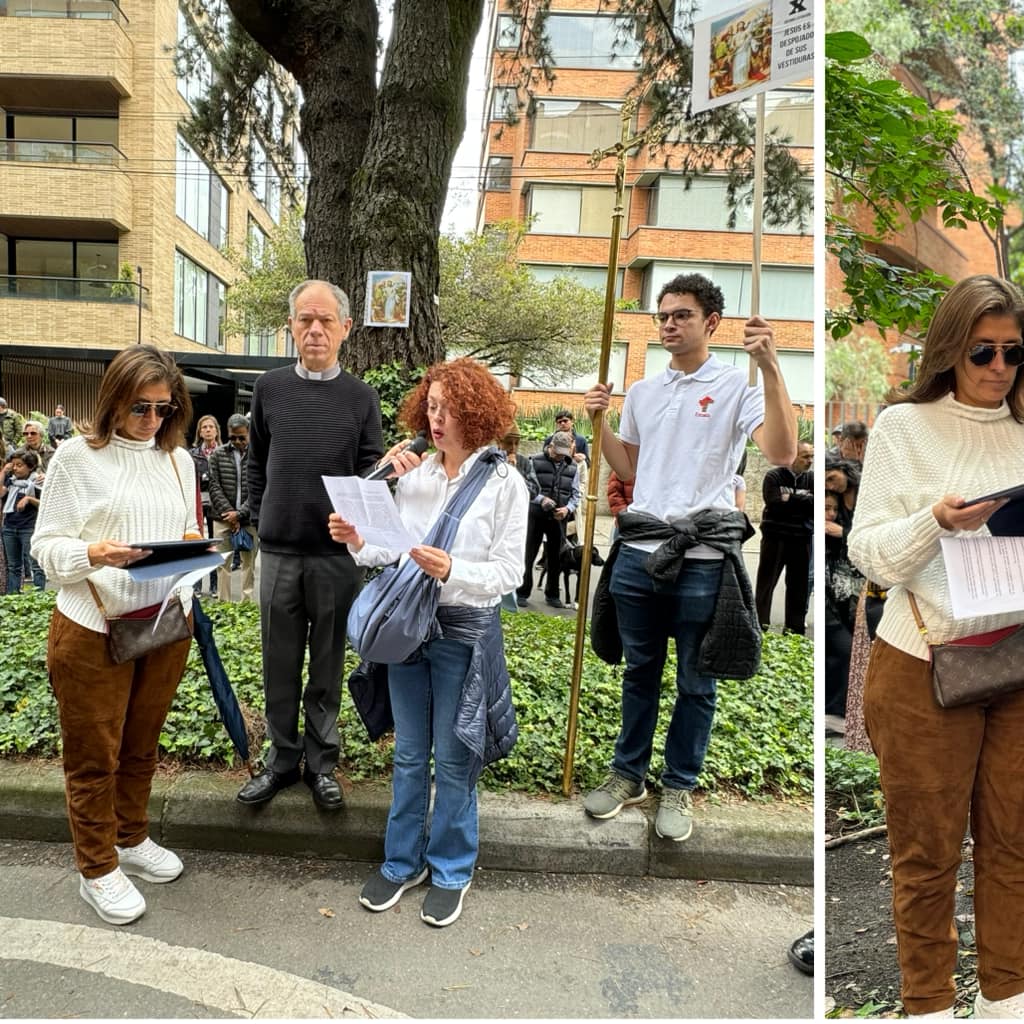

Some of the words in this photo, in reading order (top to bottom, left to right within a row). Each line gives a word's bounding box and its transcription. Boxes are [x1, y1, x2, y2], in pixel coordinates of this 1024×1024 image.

[802, 21, 811, 31] ES
[779, 31, 814, 48] DESPOJADO
[785, 47, 793, 57] DE
[794, 43, 807, 54] SUS
[777, 52, 815, 70] VESTIDURAS
